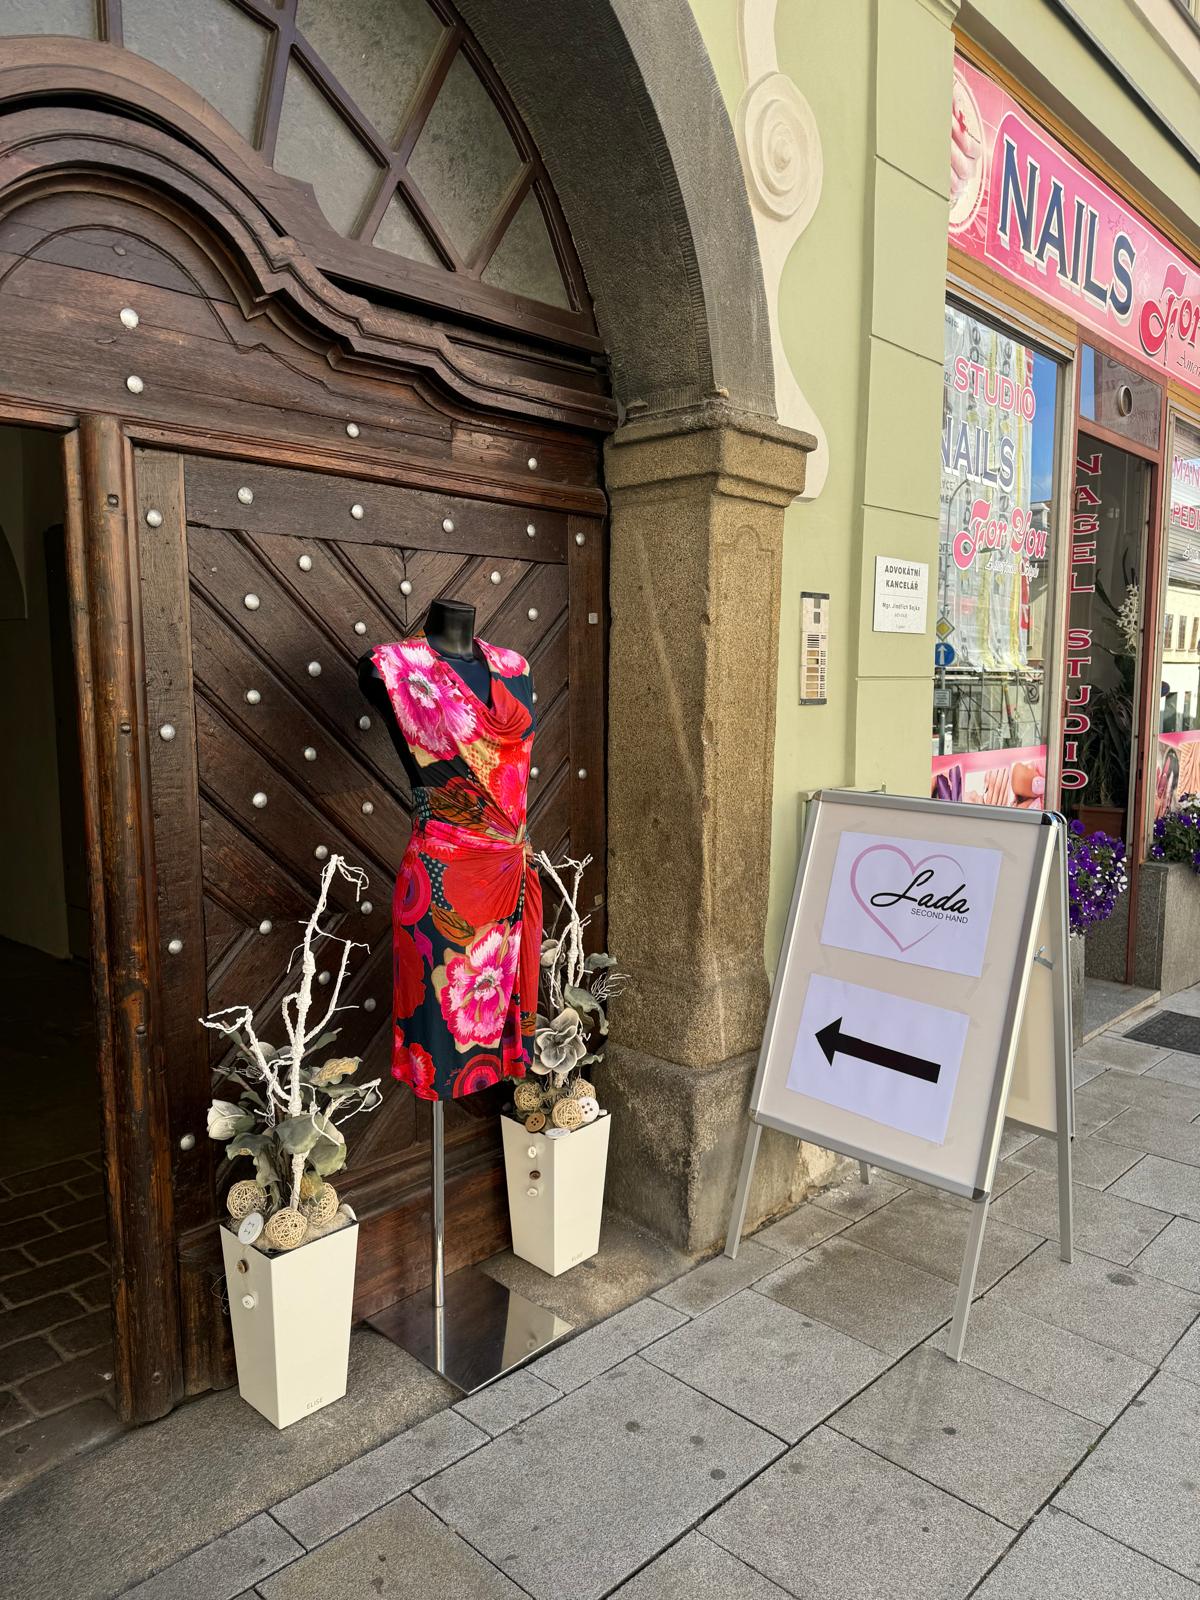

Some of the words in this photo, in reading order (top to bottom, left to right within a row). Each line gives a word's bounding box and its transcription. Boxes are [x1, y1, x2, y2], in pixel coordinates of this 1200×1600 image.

[998, 133, 1136, 321] NAILS
[954, 355, 1036, 422] STUDIO
[953, 498, 1008, 573] For
[1010, 506, 1048, 559] You
[1070, 453, 1102, 593] NAGEL
[885, 565, 921, 577] ADVOKÁTNÍ
[885, 579, 919, 591] KANCELÁŘ
[1061, 629, 1092, 790] STUDIO
[870, 869, 970, 914] Lada
[910, 907, 944, 920] SECOND
[945, 914, 969, 924] HAND
